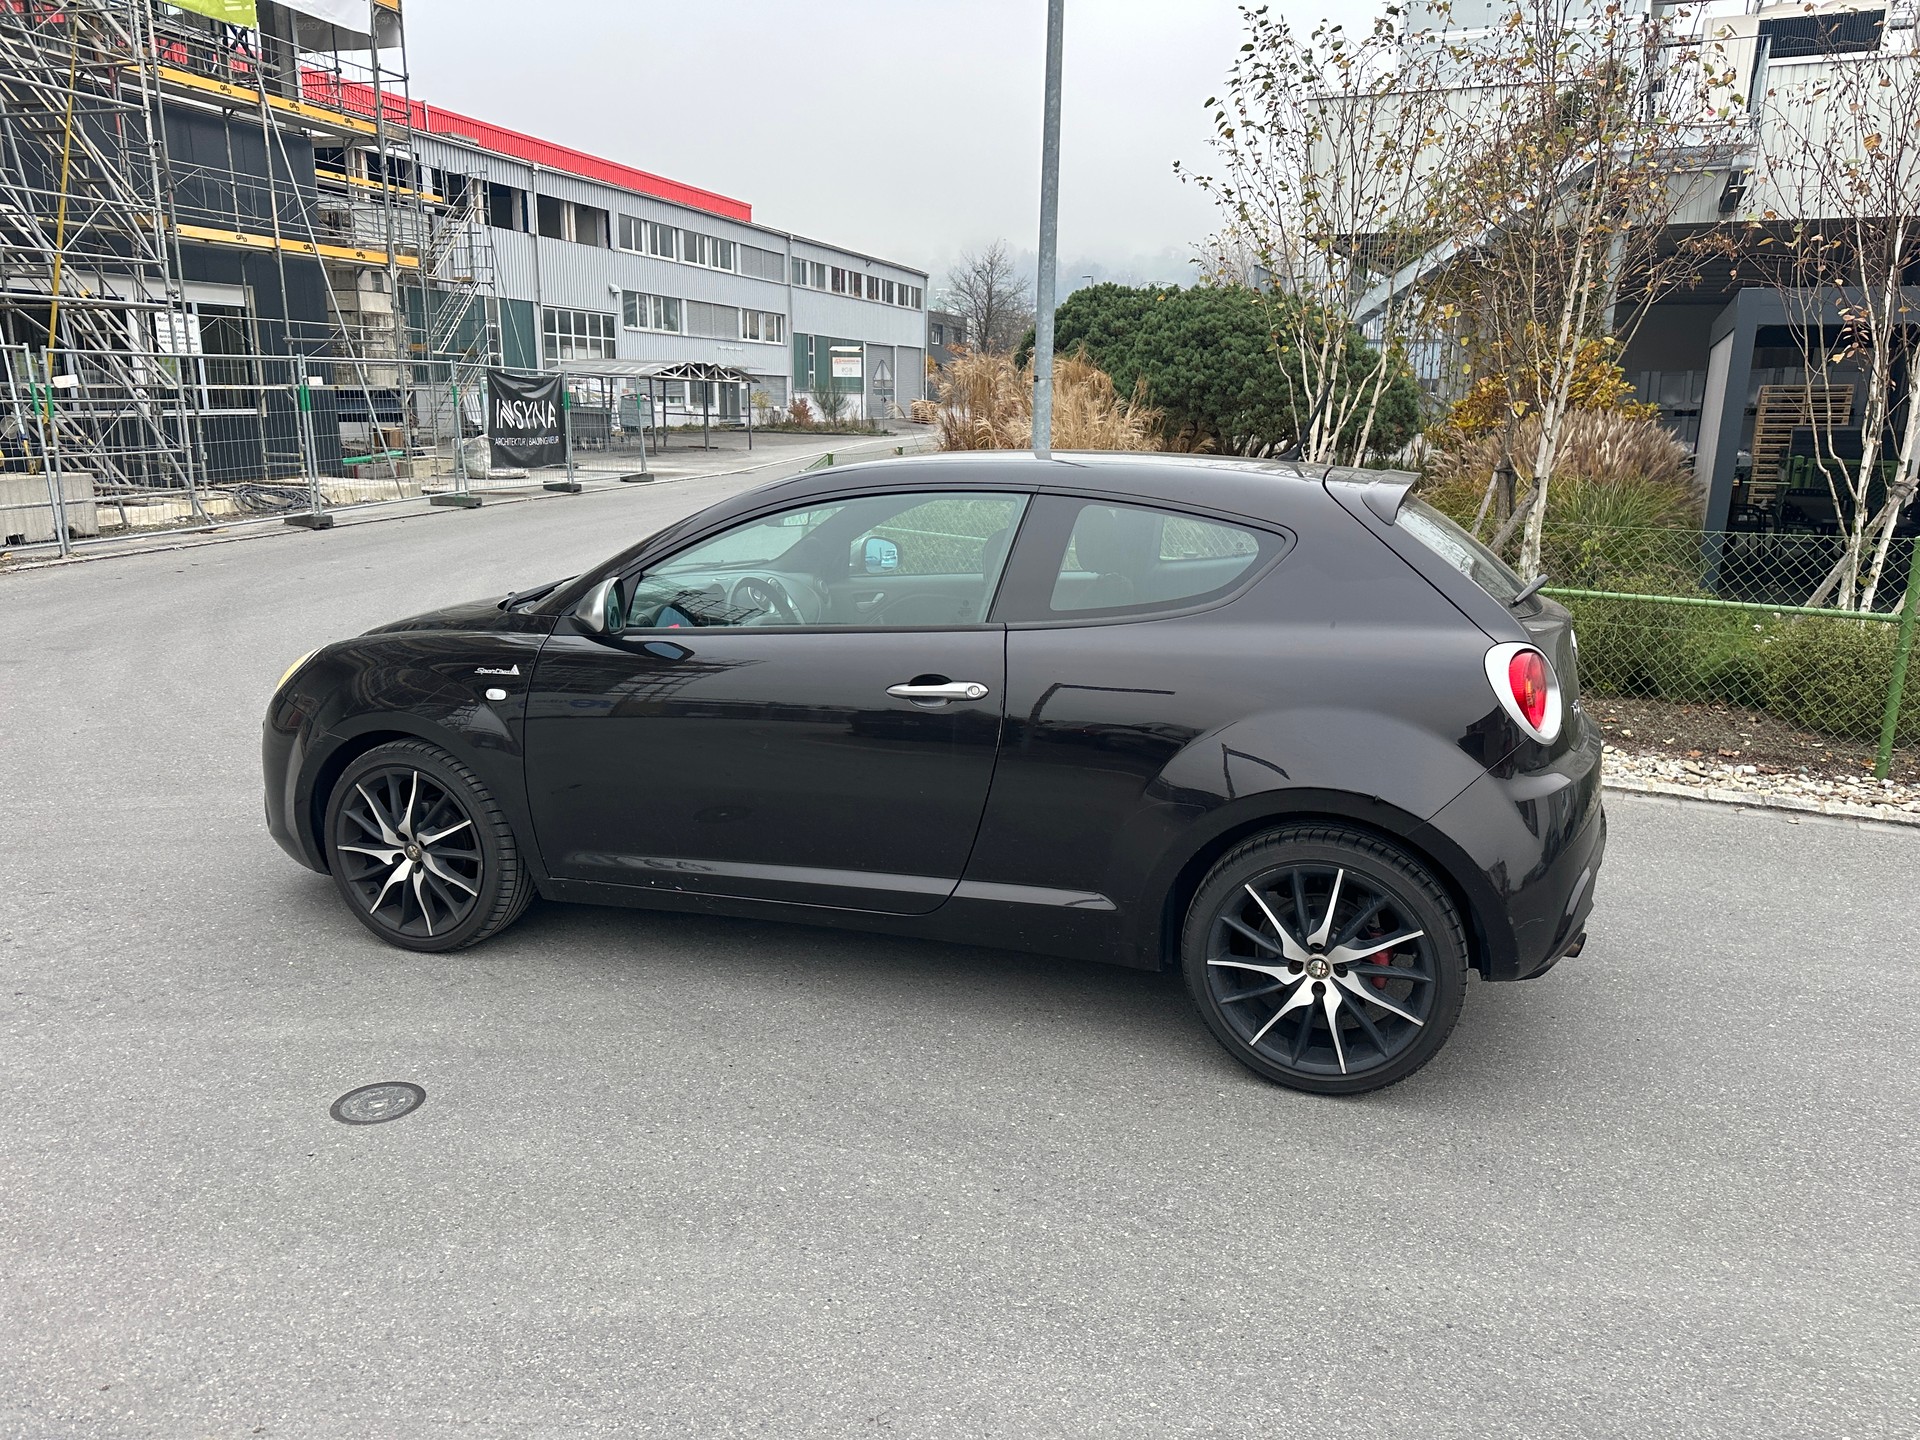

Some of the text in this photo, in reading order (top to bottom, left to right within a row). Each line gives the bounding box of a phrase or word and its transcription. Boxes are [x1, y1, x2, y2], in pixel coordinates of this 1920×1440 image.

[496, 398, 557, 430] INSYNA
[494, 435, 560, 446] ARCHITEKTUR BAUINGNIEUR
